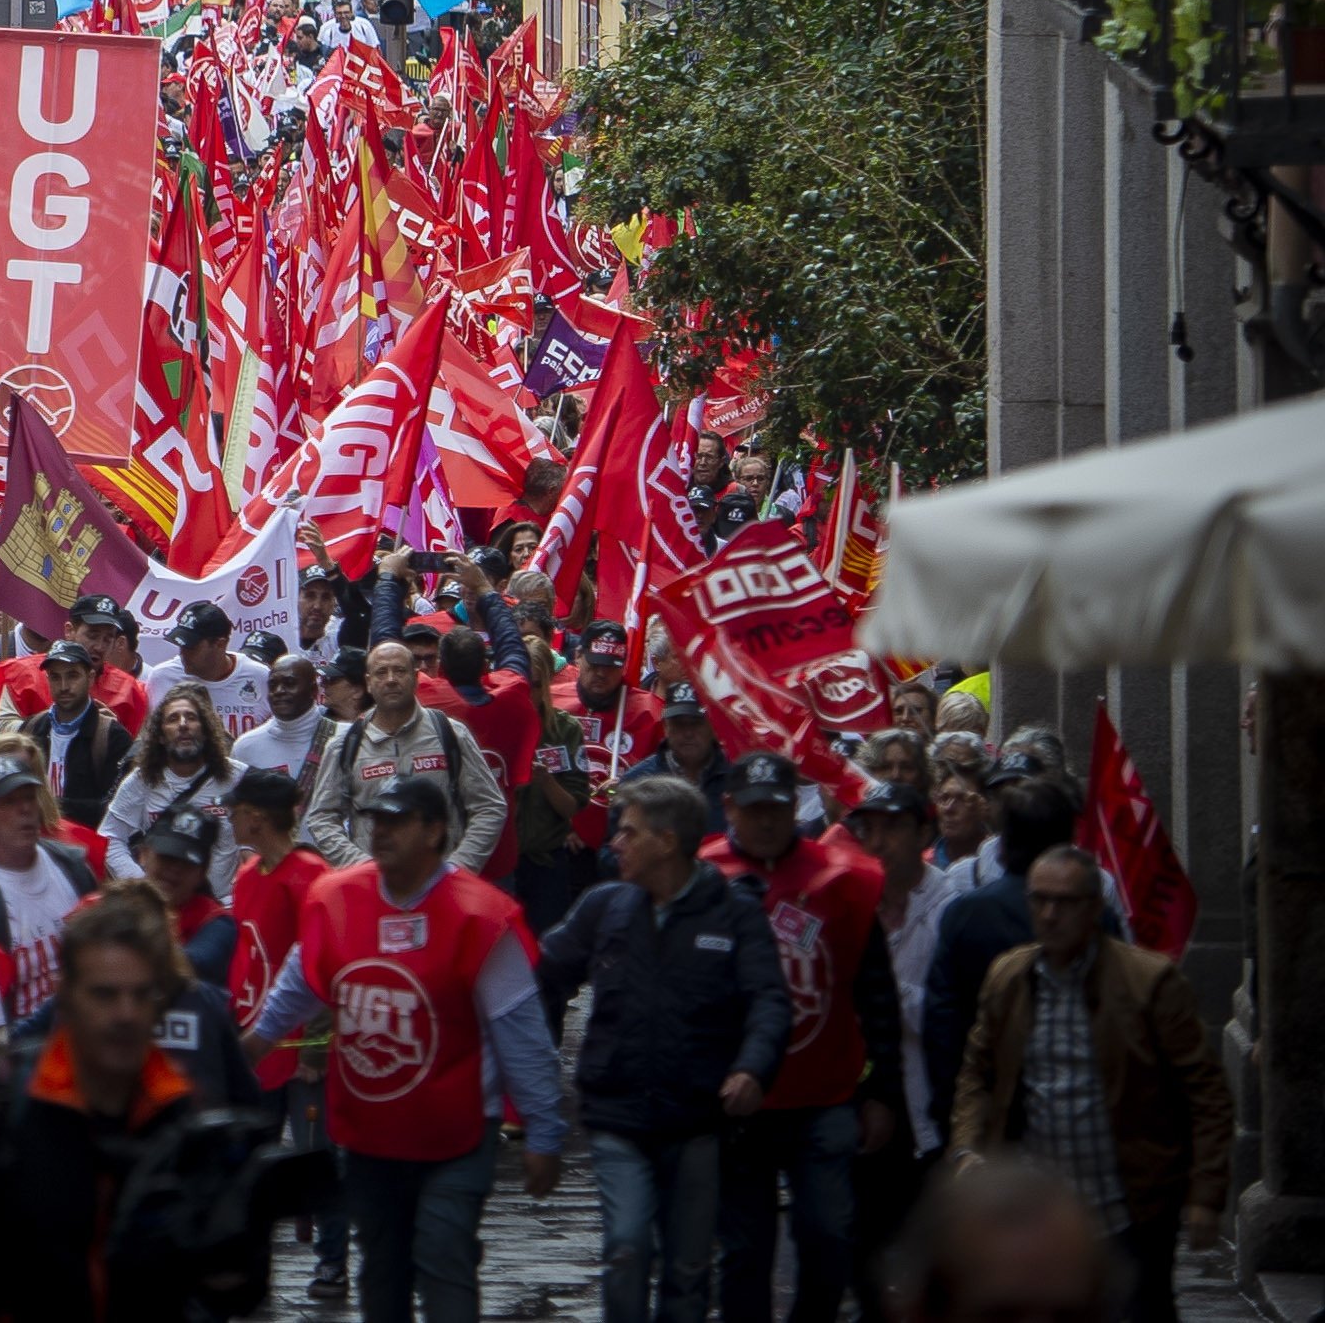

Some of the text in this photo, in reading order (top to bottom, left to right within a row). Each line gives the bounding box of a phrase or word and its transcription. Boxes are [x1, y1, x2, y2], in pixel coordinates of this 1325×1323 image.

[6, 45, 98, 353] UGT
[304, 379, 400, 521] UGT
[232, 609, 289, 634] Mancha
[414, 758, 437, 770] UGT
[338, 983, 418, 1044] UGT
